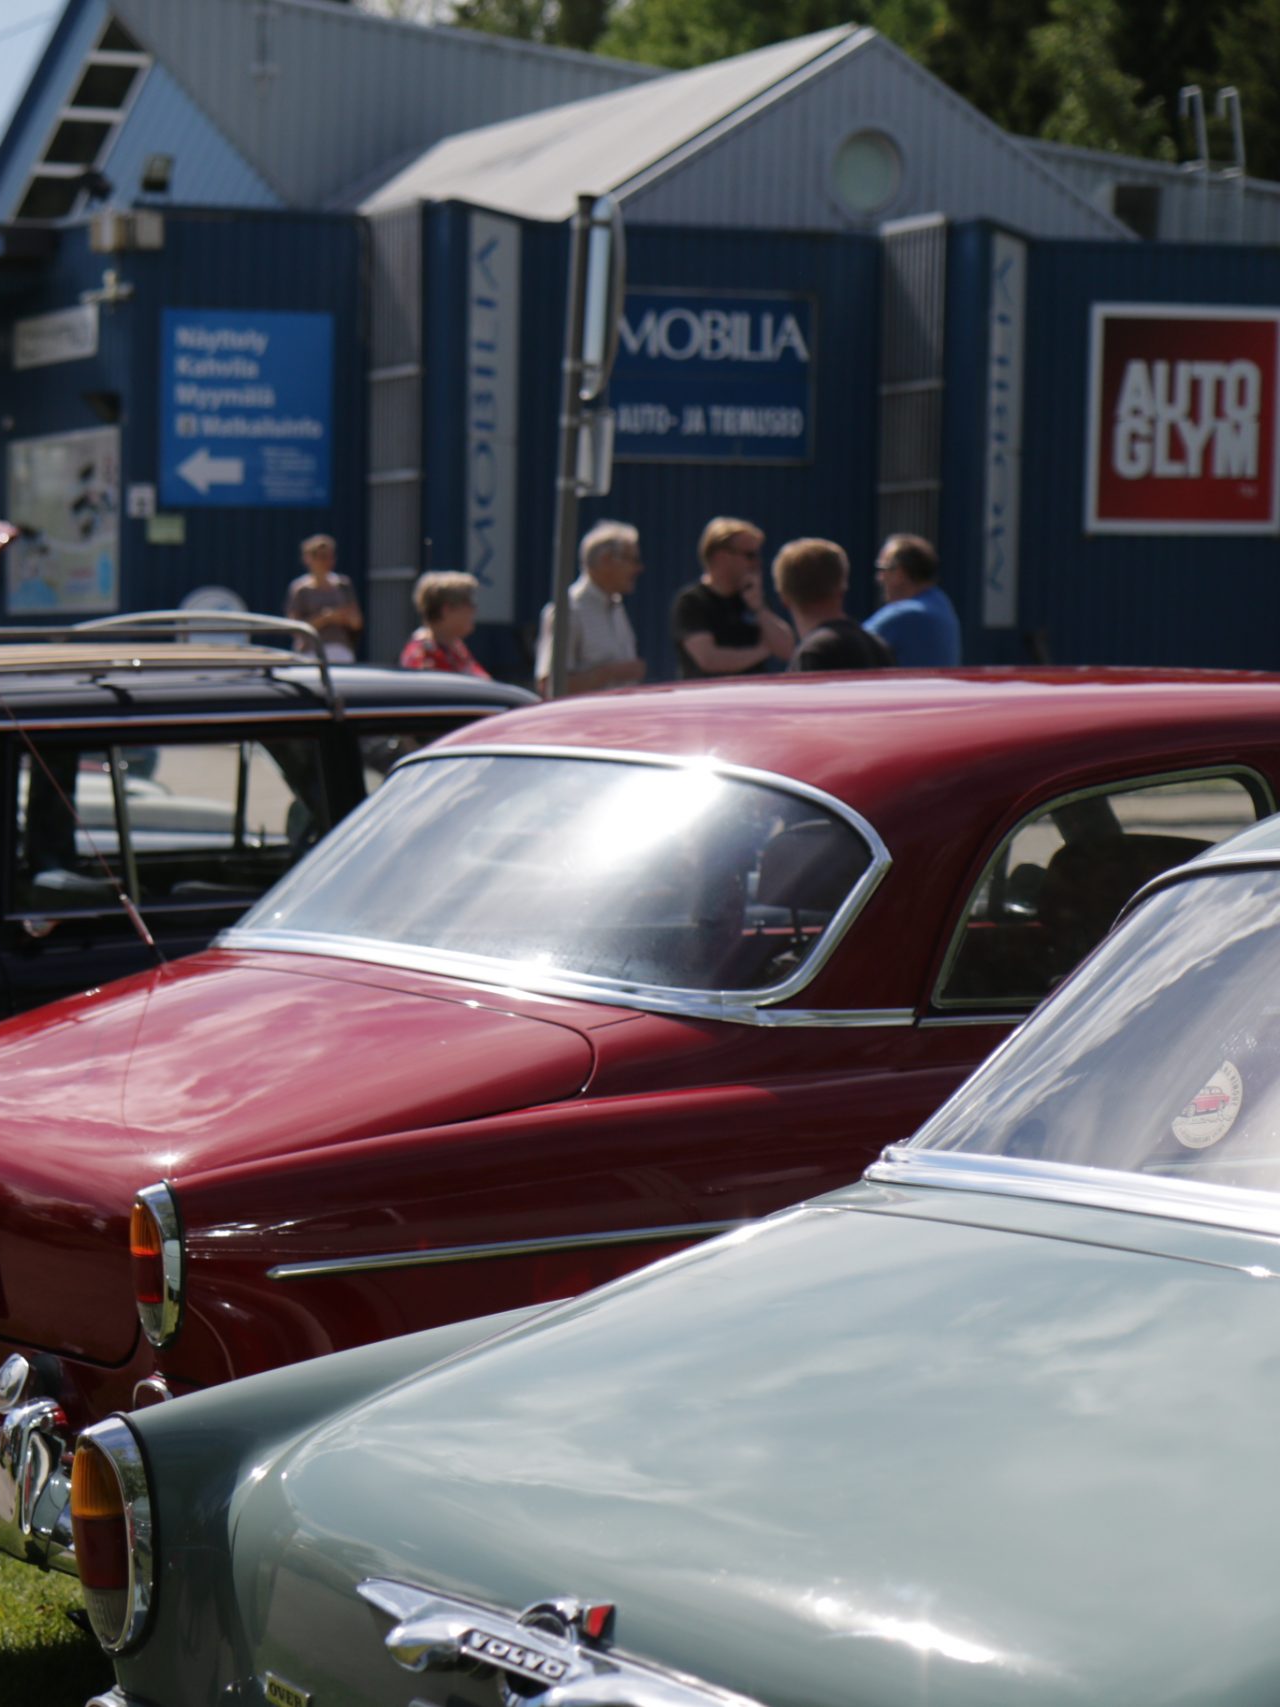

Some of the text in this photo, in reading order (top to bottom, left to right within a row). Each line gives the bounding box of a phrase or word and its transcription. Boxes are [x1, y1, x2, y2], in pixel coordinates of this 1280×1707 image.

[618, 308, 810, 362] MOBILIA
[1116, 358, 1261, 423] AUTO
[1112, 418, 1260, 481] GLYM
[469, 1630, 566, 1679] VOLVO
